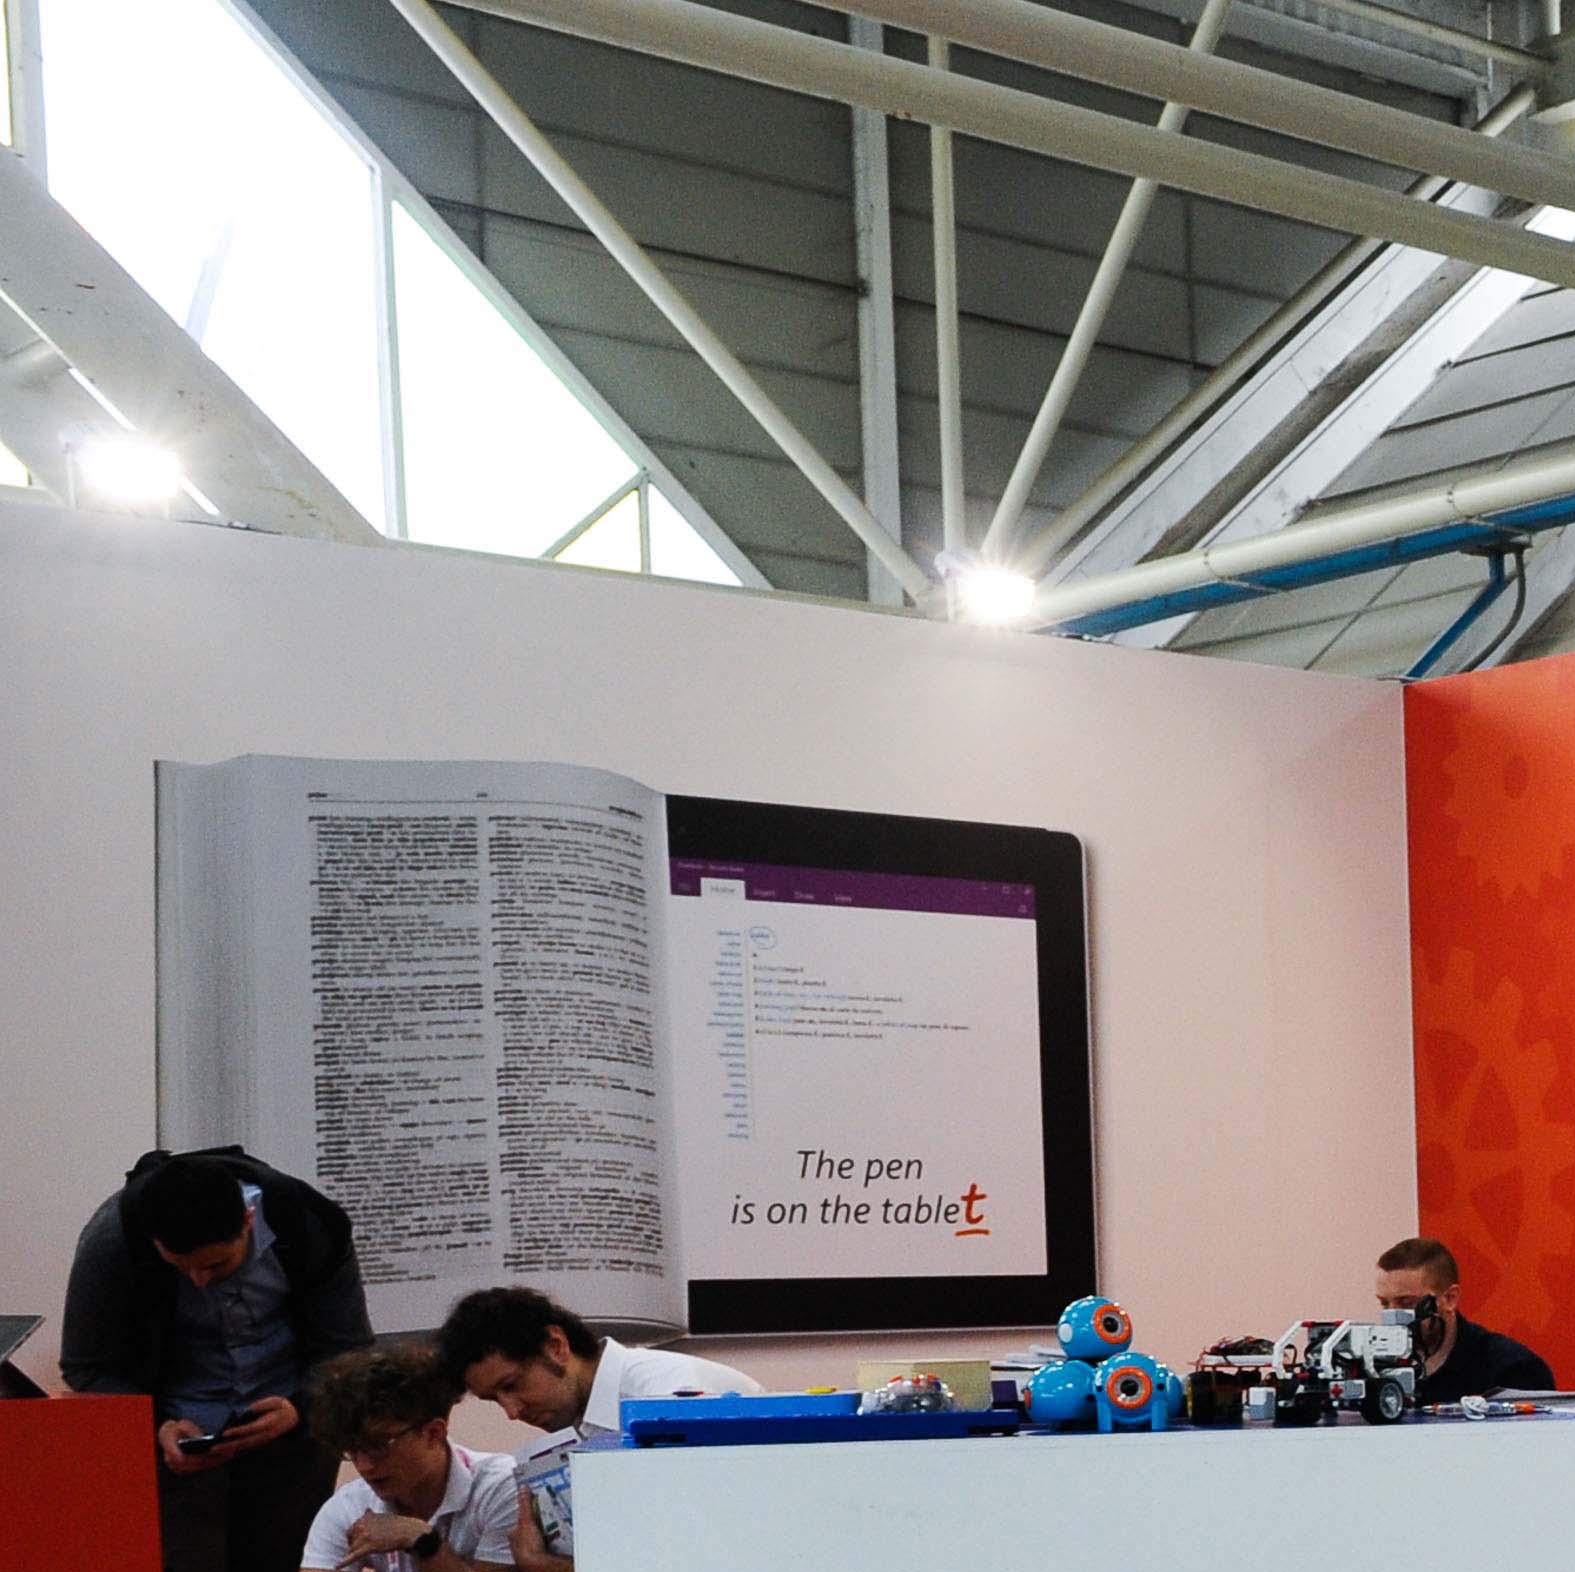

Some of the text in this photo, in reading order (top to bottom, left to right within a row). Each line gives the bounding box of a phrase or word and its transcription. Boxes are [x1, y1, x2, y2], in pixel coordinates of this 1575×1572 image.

[797, 1150, 923, 1187] The pen
[731, 1183, 988, 1227] is on the tablet
